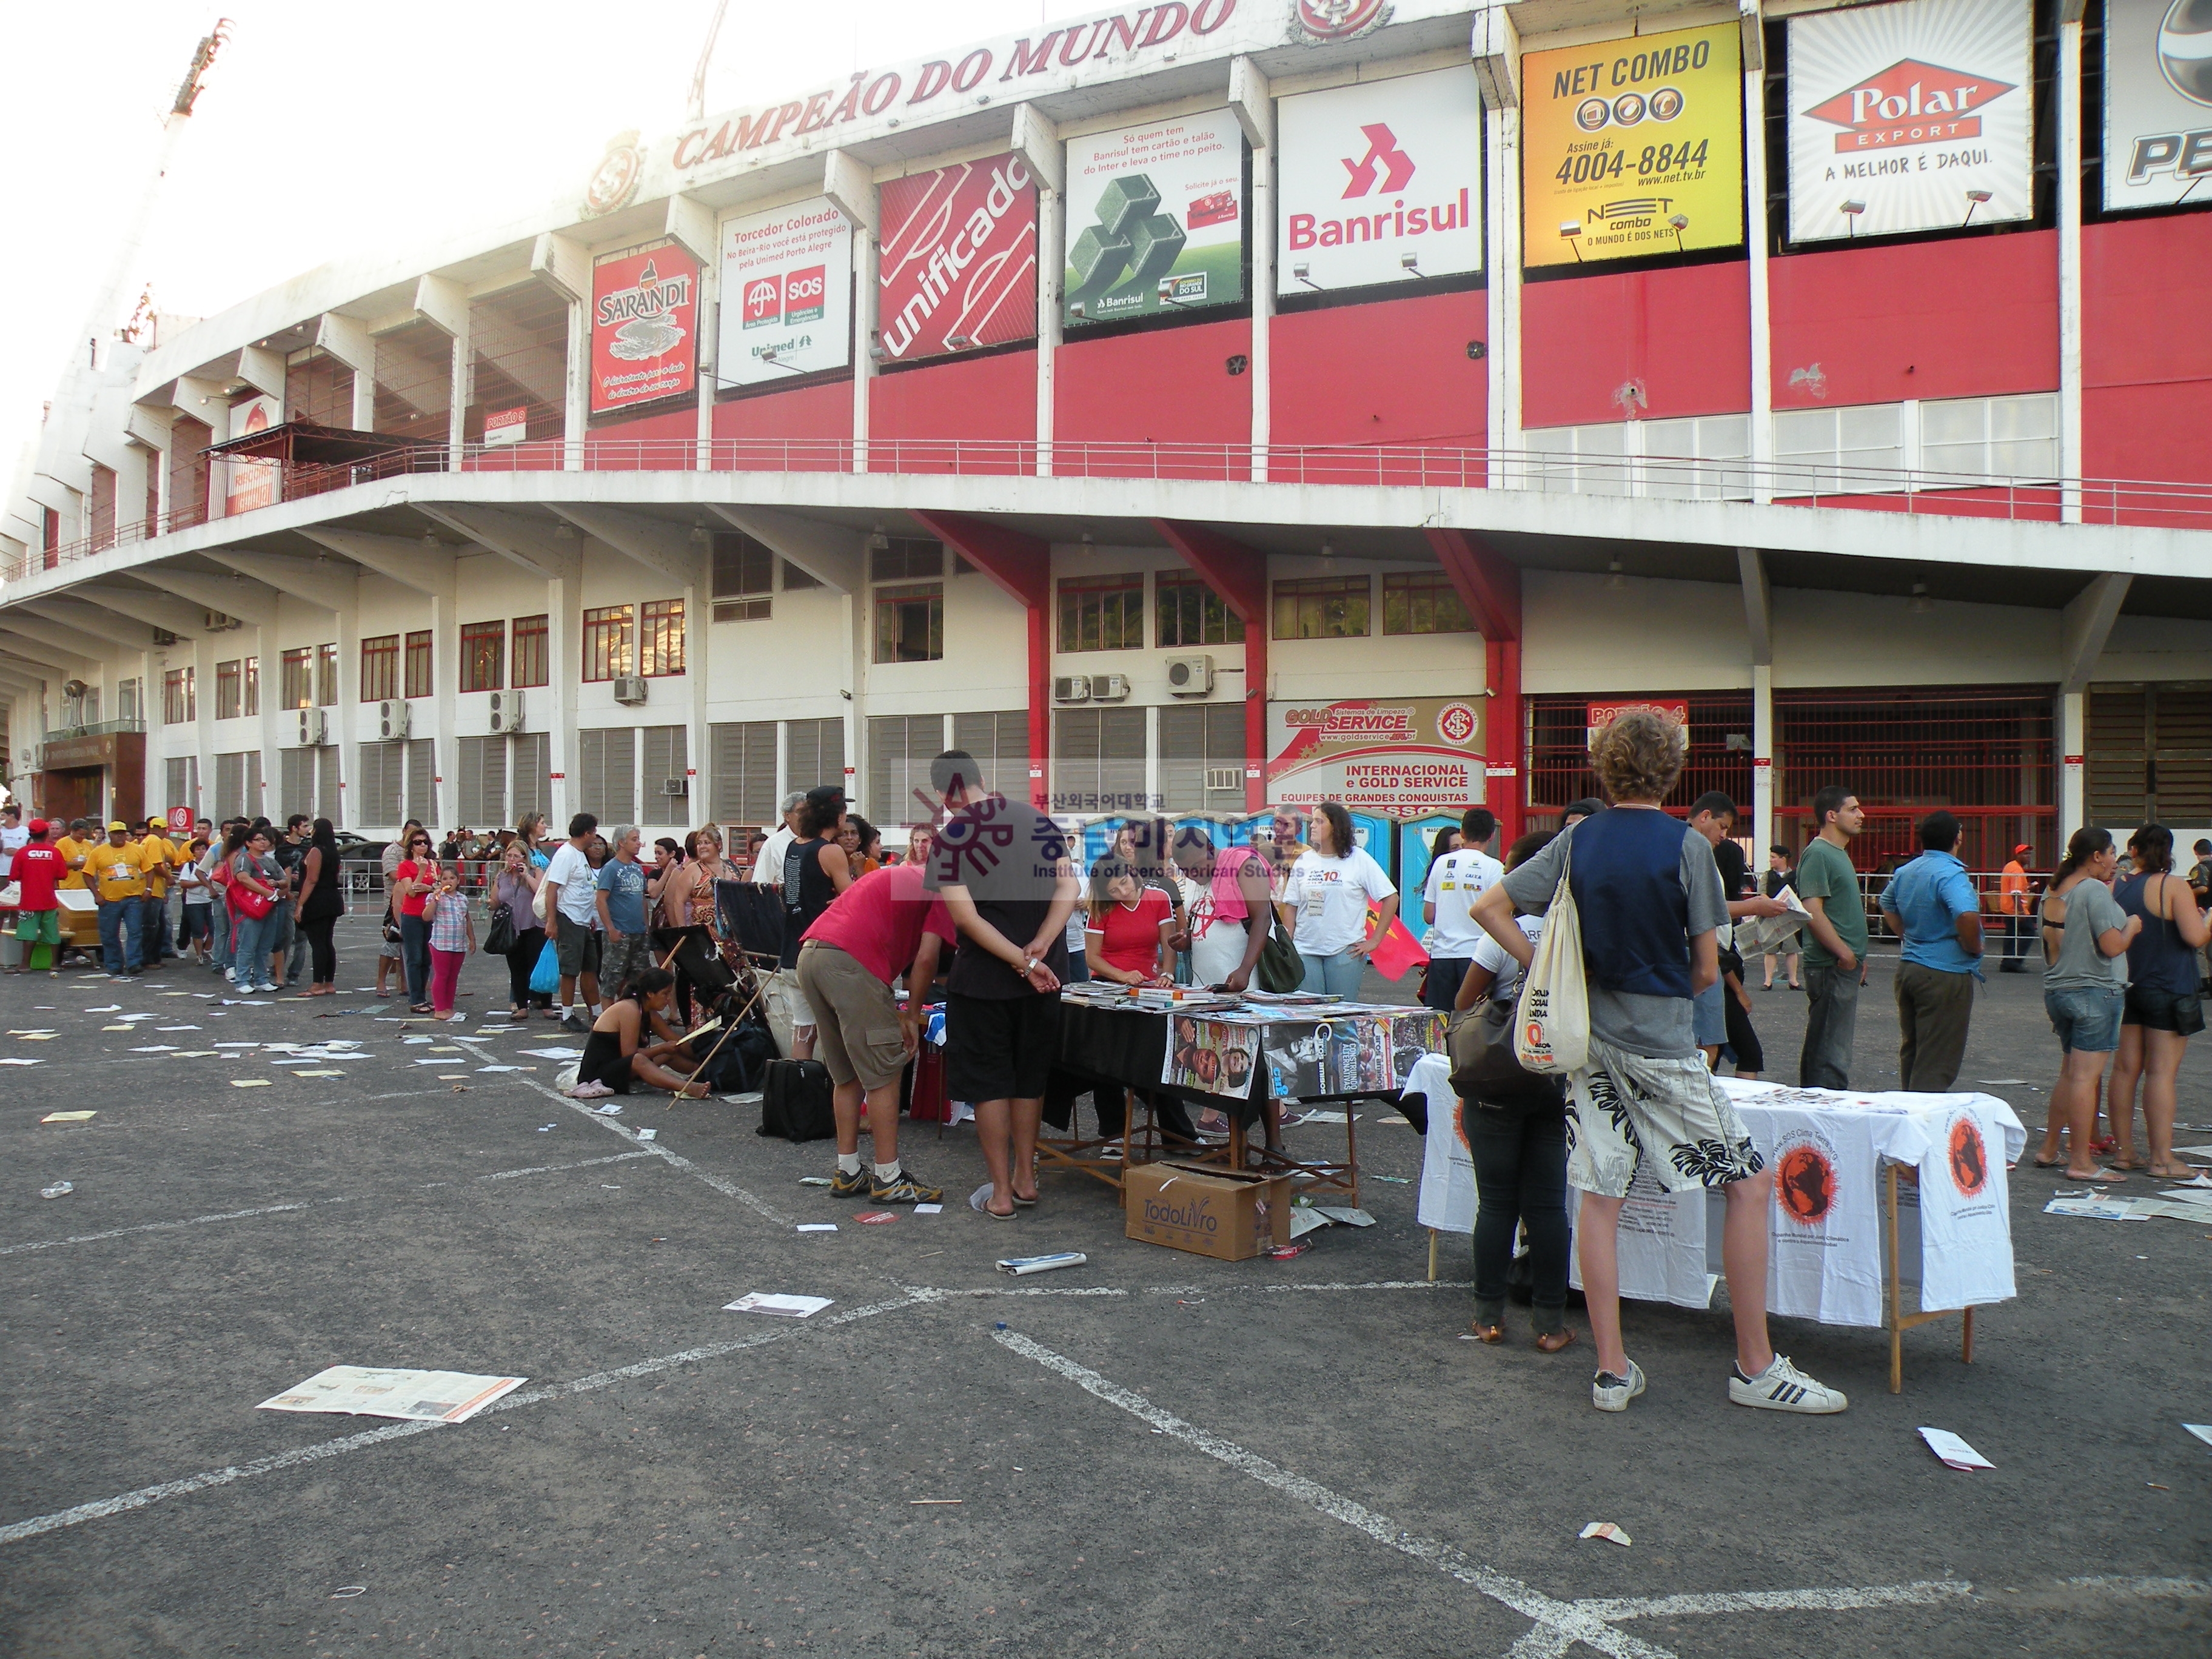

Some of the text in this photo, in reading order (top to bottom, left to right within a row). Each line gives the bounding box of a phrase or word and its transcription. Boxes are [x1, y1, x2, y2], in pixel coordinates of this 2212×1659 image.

[1553, 40, 1710, 99] NET COMBO
[672, 0, 1238, 170] CAMPEÃO DO MUNDO
[1849, 81, 1979, 123] Polar
[1093, 147, 1129, 161] Banrisul
[1131, 145, 1149, 155] tem
[1151, 138, 1181, 151] cartão
[1191, 131, 1215, 143] talão
[1123, 126, 1184, 144] Só quem tem
[1567, 138, 1614, 154] Assine já:
[1857, 123, 1959, 146] EXPORT
[1084, 165, 1096, 175] do
[1098, 159, 1119, 172] Inter
[1130, 157, 1148, 167] leva
[1159, 150, 1181, 161] time
[1183, 147, 1195, 156] no
[1197, 142, 1225, 156] peito.
[1555, 138, 1709, 185] 4004-8844
[1825, 149, 1992, 181] A MELHOR É DAQUI.
[1185, 181, 1210, 191] Solicite
[1211, 179, 1218, 188] já
[1638, 169, 1707, 187] www.net.tv.br
[735, 208, 839, 244] Torcedor Colorado
[1290, 189, 1469, 251] Banrisul
[1610, 216, 1651, 230] combo
[727, 224, 846, 260] No Beira-Rio você está protegido
[1587, 228, 1674, 246] O MUNDO É DOS NETS
[739, 241, 833, 271] pela Unimed Porto Alegre
[883, 156, 1031, 358] unificado
[788, 276, 823, 300] SOS
[1106, 292, 1144, 308] Banrisul
[1190, 285, 1203, 293] SUL
[598, 280, 688, 326] SARANDI
[487, 411, 526, 429] PORTÃO 9
[1285, 709, 1333, 724] GOLD
[1377, 708, 1406, 717] Limpeza
[1328, 715, 1409, 730] SERVICE
[1346, 765, 1469, 776] INTERNACIONAL
[1346, 776, 1469, 788] e GOLD SERVICE
[1281, 793, 1469, 802] EQUIPES DE GRANDES CONQUISTAS
[1323, 871, 1338, 882] 10
[1318, 1061, 1327, 1095] amigos
[1342, 1043, 1351, 1091] ALTERNATIVAS
[1349, 1042, 1358, 1090] CONSTRUINDO
